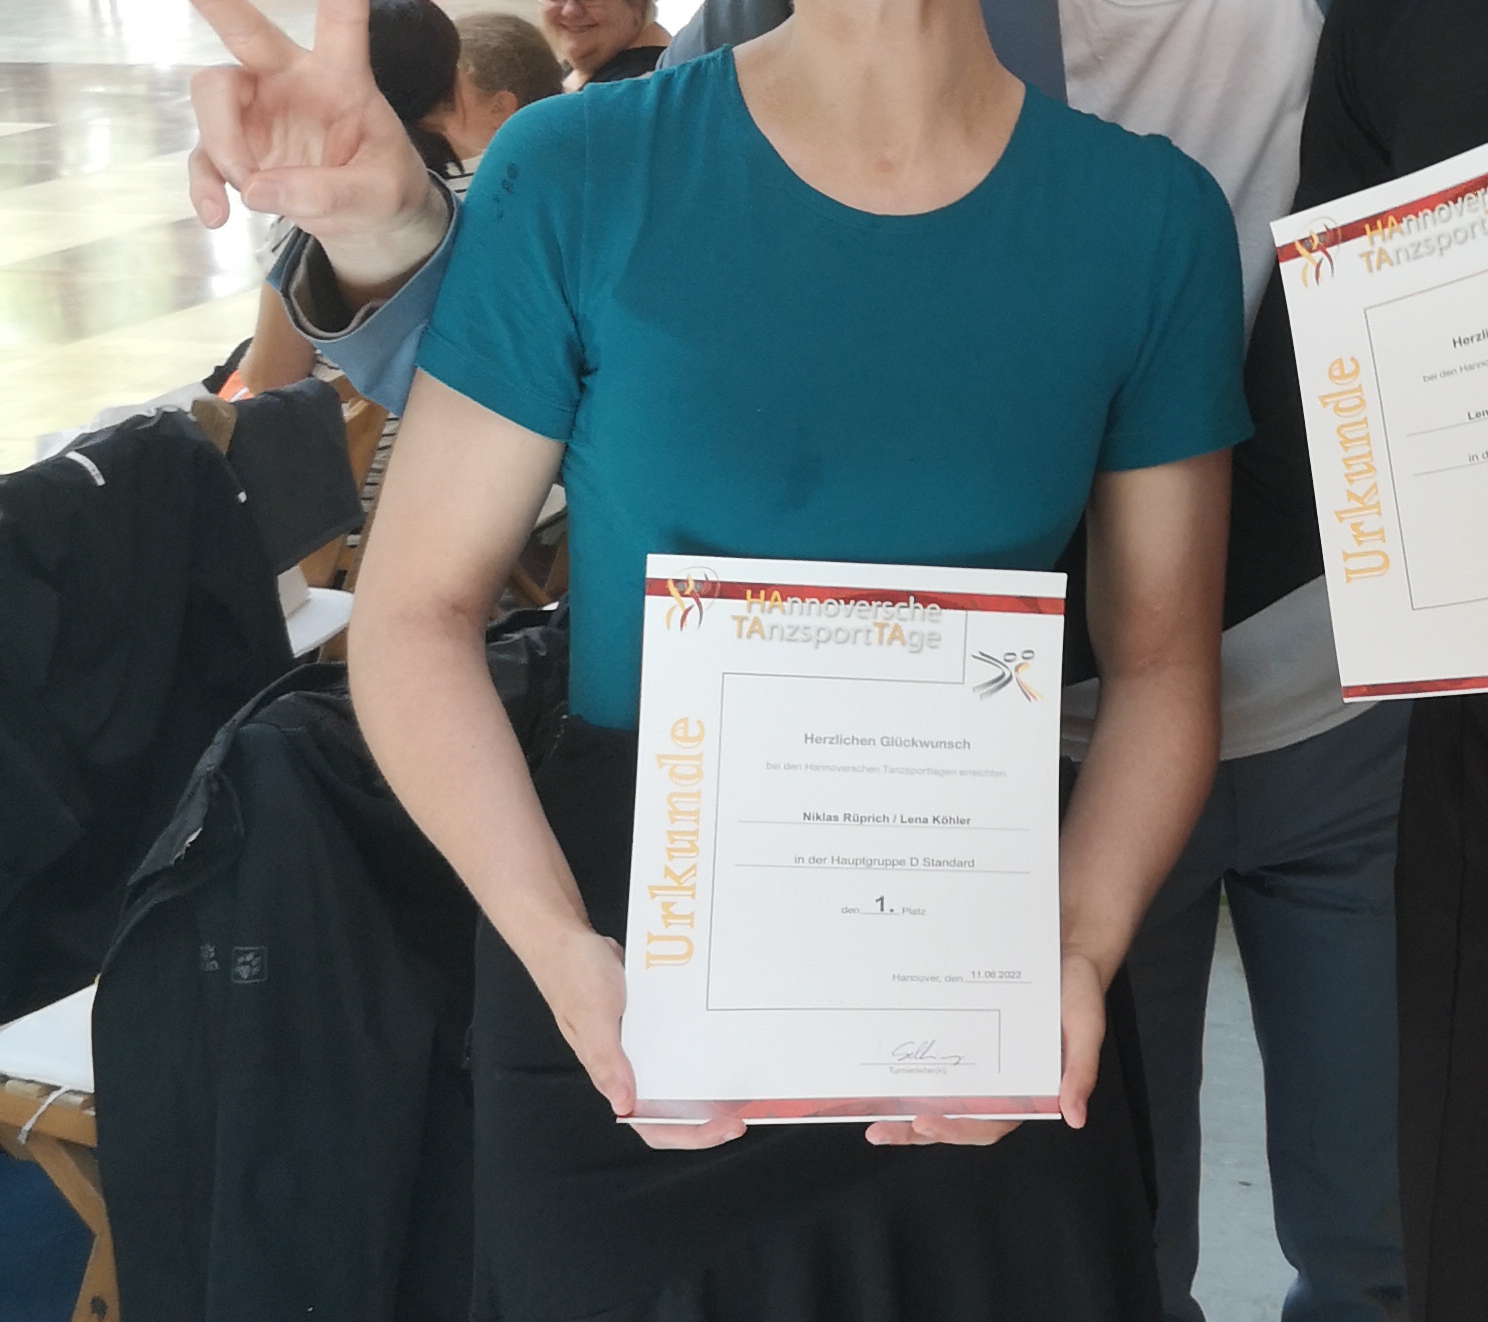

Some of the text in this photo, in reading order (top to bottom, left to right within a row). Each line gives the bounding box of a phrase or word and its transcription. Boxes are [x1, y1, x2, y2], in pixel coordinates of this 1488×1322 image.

[1422, 373, 1438, 383] bei
[1440, 367, 1458, 379] den
[1468, 452, 1480, 463] in
[1318, 356, 1391, 584] Urkunde
[745, 589, 942, 622] HAnnoversche
[731, 615, 942, 654] TAnzsportTAge
[804, 733, 971, 750] Herzlichen Glückwunsch
[766, 762, 781, 770] bei
[783, 762, 802, 770] den
[805, 763, 880, 773] Hannoverschen
[803, 812, 839, 822] Niklas
[843, 813, 890, 825] Rüprich
[900, 814, 929, 824] Lena
[932, 815, 972, 825] Köhler
[645, 716, 705, 970] Urkunde
[794, 855, 975, 868] in der Hauptgruppe D Standard
[841, 895, 926, 915] den 1. Platz
[892, 973, 942, 982] Hannover,
[944, 974, 964, 982] den
